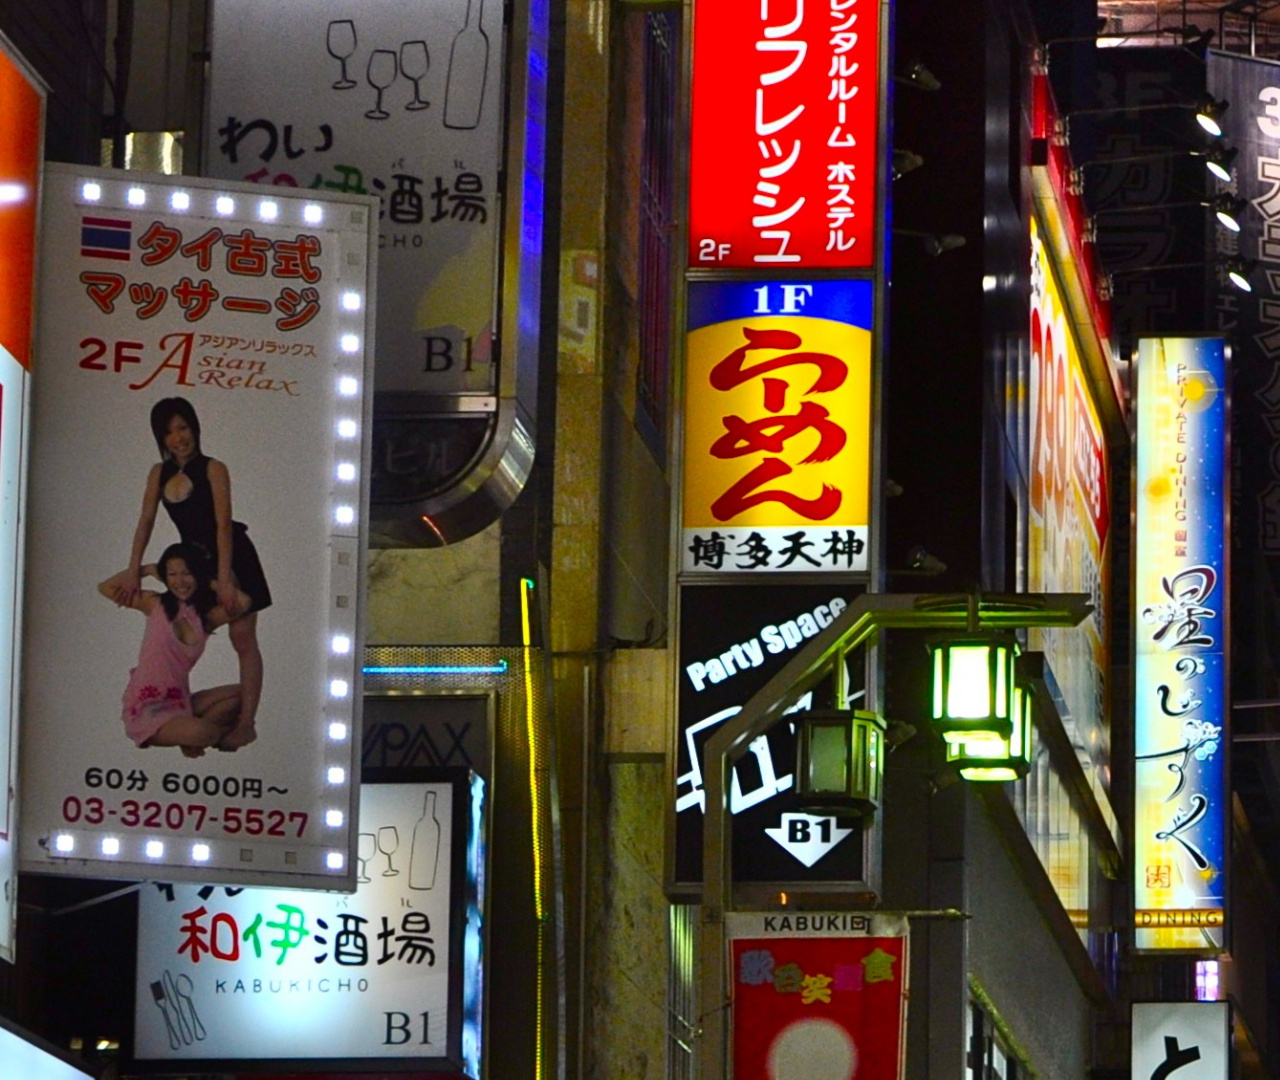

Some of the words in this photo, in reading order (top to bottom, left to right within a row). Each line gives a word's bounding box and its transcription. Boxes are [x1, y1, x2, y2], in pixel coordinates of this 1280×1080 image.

[219, 116, 333, 163] わい
[138, 223, 321, 283] タイ古式
[698, 240, 731, 261] 2F
[79, 271, 321, 331] マッサージ
[752, 285, 814, 314] 1F
[79, 338, 144, 372] 2F
[423, 336, 477, 373] B1
[199, 371, 300, 396] Relax
[709, 327, 849, 522] らーめん
[687, 529, 865, 570] 博多天神
[686, 645, 766, 692] Party
[765, 597, 848, 656] Space
[84, 766, 150, 793] 60分
[62, 796, 309, 839] 03-3207-5527
[786, 819, 834, 844] B1
[177, 903, 437, 967] 和伊酒場
[1141, 910, 1219, 926] DINING
[214, 979, 371, 995] KABUKICHO
[381, 1010, 433, 1051] B1
